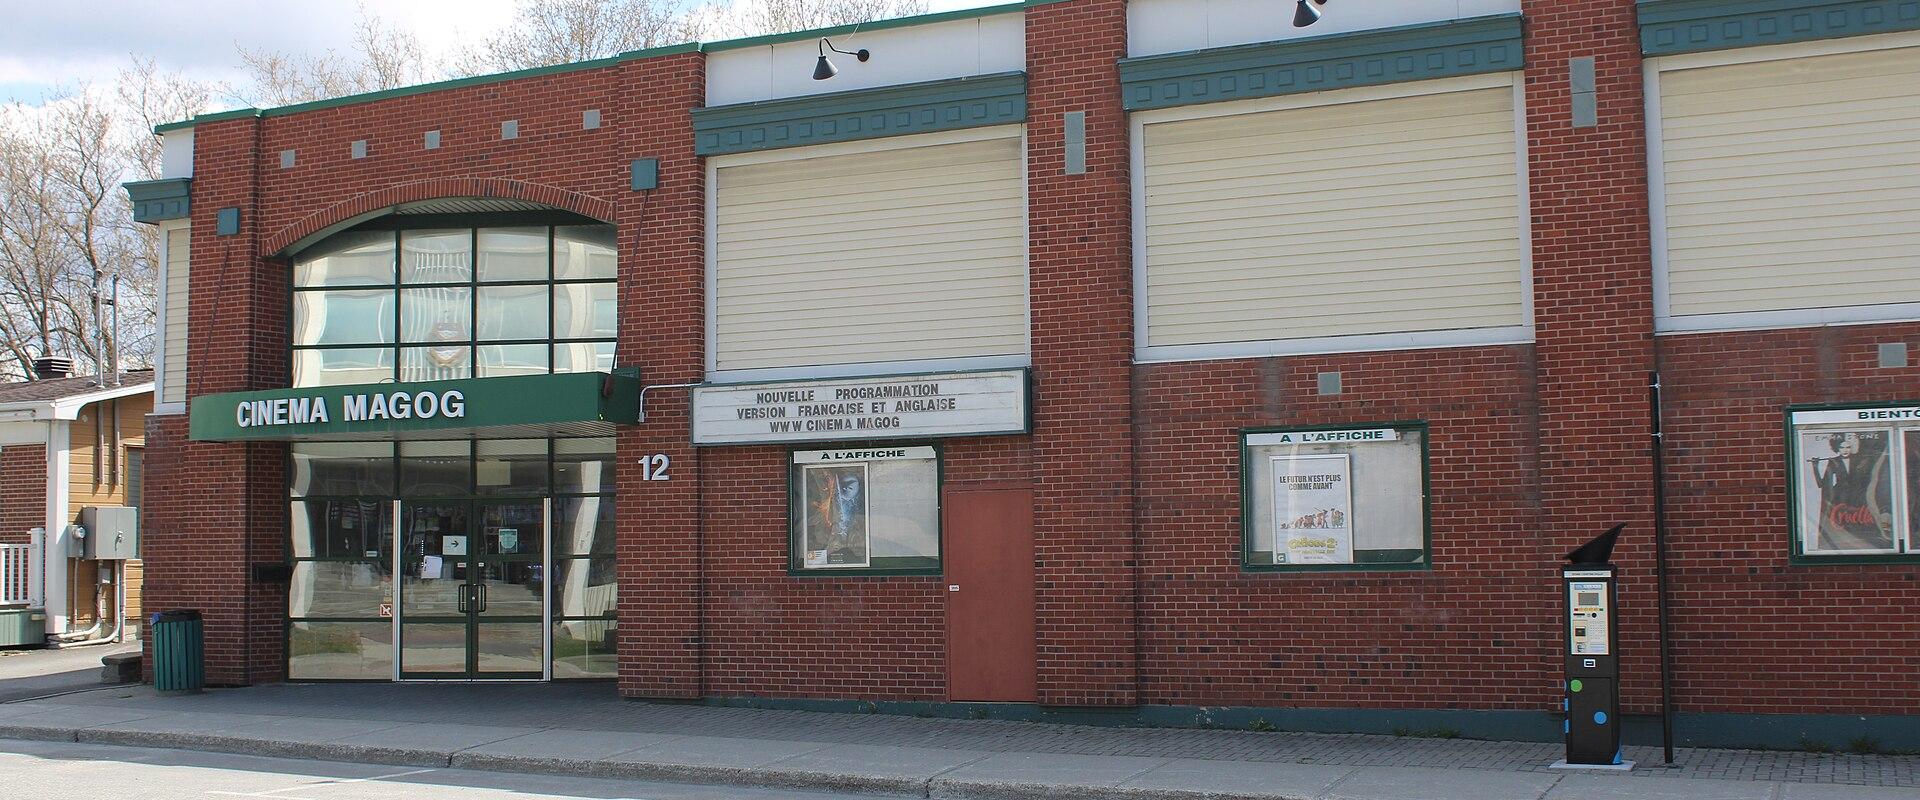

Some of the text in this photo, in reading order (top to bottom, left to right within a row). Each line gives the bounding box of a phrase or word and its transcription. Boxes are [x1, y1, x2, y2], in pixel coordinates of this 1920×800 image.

[756, 383, 939, 404] NOUVELLE PROGRAMMATION
[236, 390, 465, 428] CINEMA MAGOG
[737, 398, 956, 419] VERSION FRANCAISE ET ANGLAISE
[857, 416, 900, 430] MAGOG
[1302, 430, 1384, 442] L'AFFICHE
[834, 449, 906, 460] L'AFFICHE
[637, 453, 670, 481] 12
[1279, 474, 1342, 484] LE FUTUR N'EST PLUS
[1288, 482, 1333, 491] COMME AVANT
